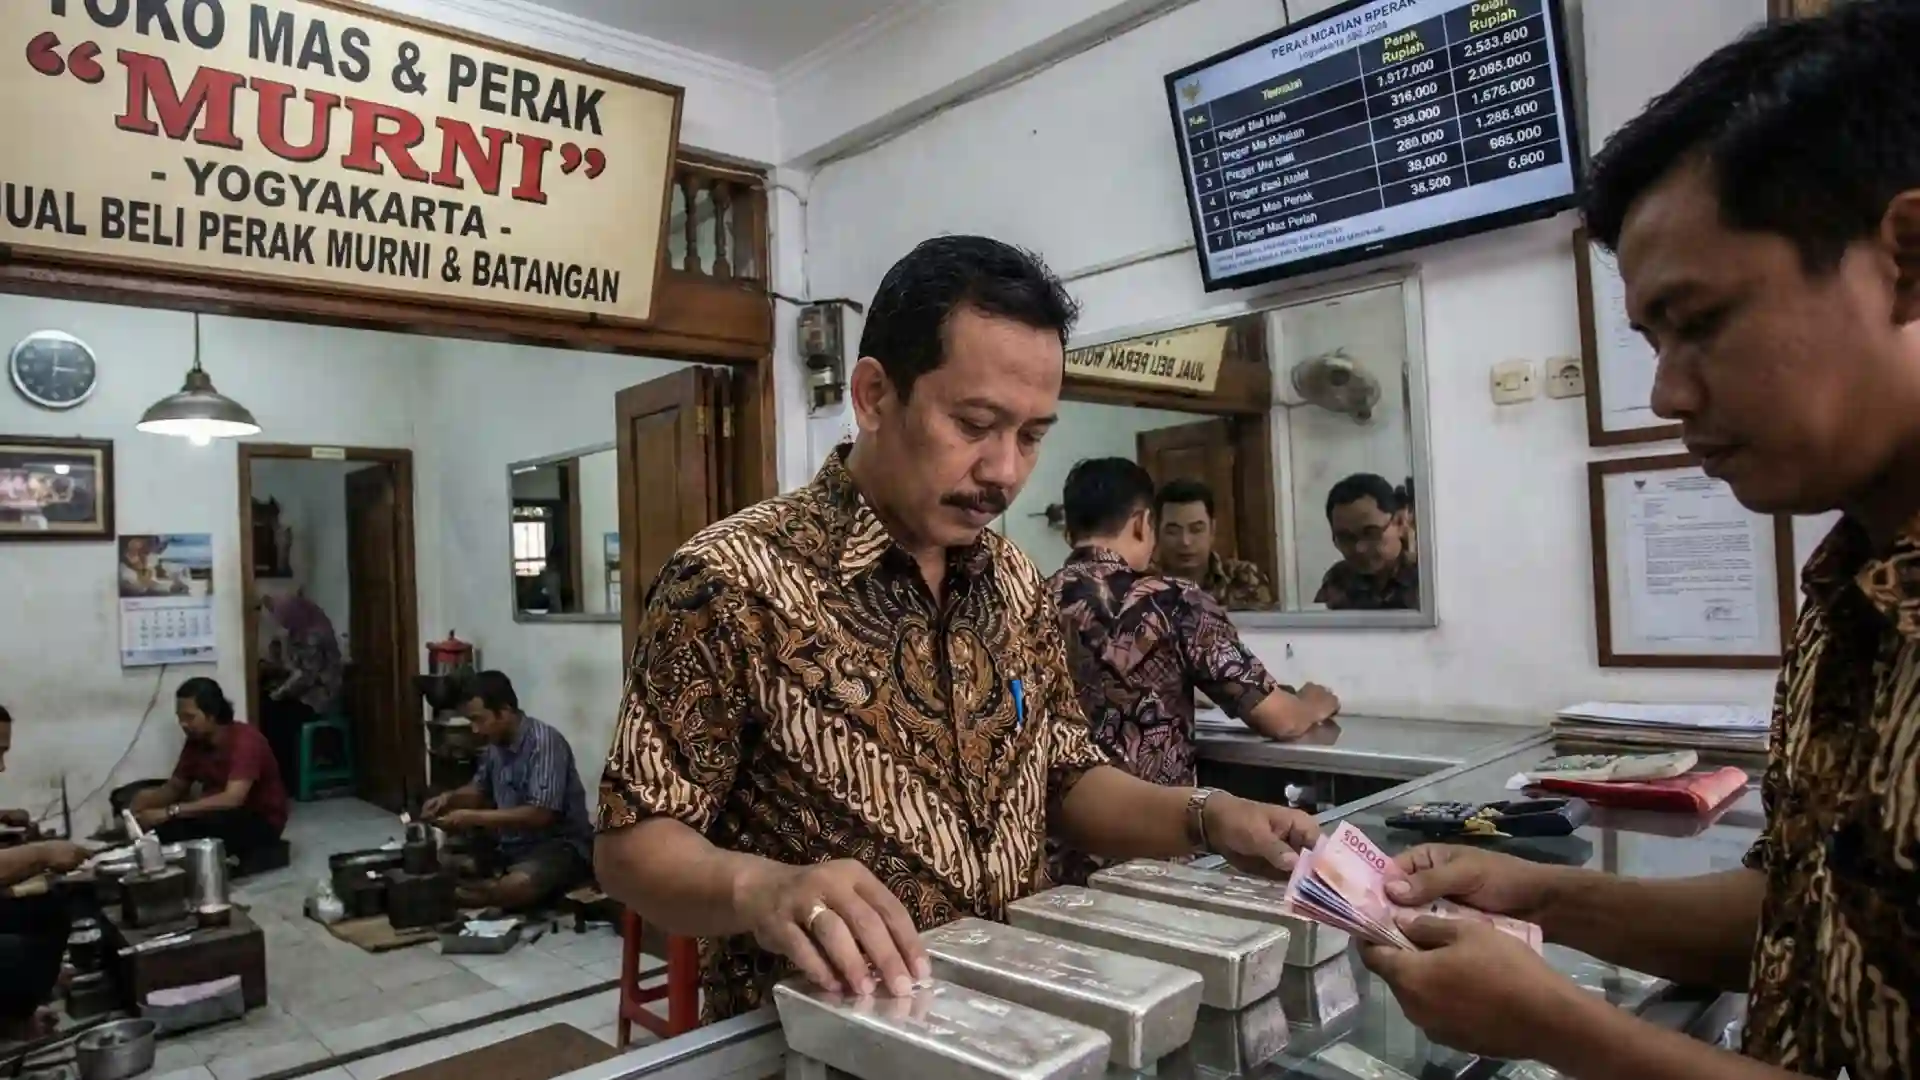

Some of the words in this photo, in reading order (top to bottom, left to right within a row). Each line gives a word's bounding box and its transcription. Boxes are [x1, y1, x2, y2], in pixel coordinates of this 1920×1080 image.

[248, 4, 370, 82] MAS
[391, 41, 427, 96] &
[448, 54, 606, 135] PERAK
[0, 180, 87, 236] UAL
[101, 196, 185, 248] BELI
[199, 210, 316, 265] PERAK
[327, 228, 430, 279] MURNI
[441, 246, 462, 283] &
[473, 249, 620, 304] BATANGAN
[184, 157, 487, 239] YOGYAKARTA
